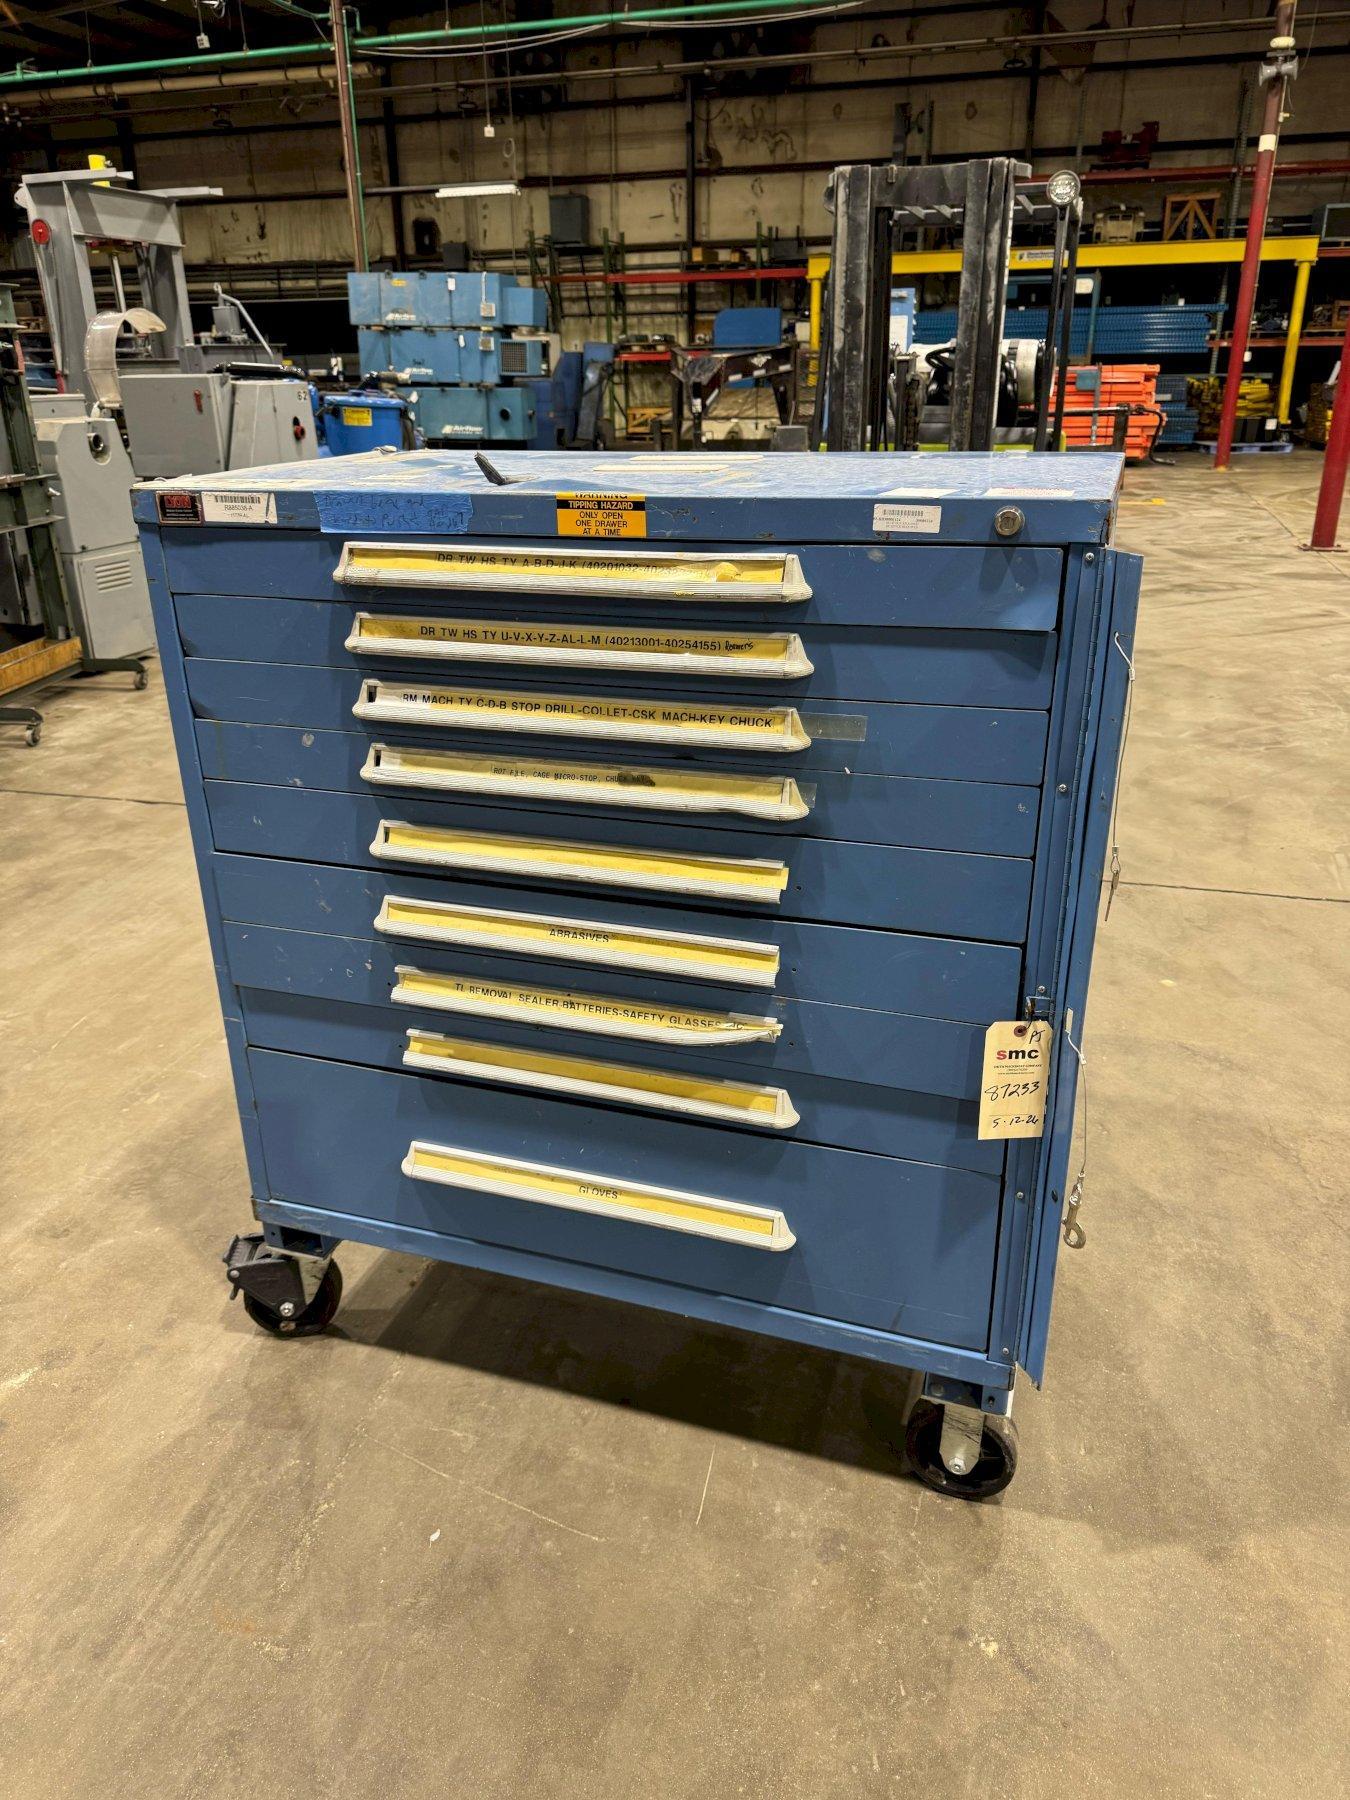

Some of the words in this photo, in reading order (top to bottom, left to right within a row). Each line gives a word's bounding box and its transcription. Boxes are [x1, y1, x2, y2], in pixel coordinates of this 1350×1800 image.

[568, 500, 599, 509] TIPPING
[601, 501, 634, 510] HAZARD
[579, 511, 599, 519] ONLY
[602, 511, 624, 519] OPEN
[575, 519, 592, 527] ONE
[595, 520, 628, 528] DRAWER
[594, 528, 600, 536] A
[603, 528, 621, 536] TIME
[458, 554, 476, 564] TW
[481, 555, 496, 566] HS
[502, 557, 517, 567] TY
[420, 625, 436, 636] DR
[441, 627, 458, 637] TW
[463, 629, 478, 639] HS
[482, 630, 497, 641] TY
[501, 631, 601, 645] U-V-X-Y-Z-AL-L-M
[605, 636, 721, 651] (40213001-40254155)
[402, 693, 418, 702] RM
[422, 694, 454, 705] MACH
[458, 697, 473, 707] TY
[476, 698, 507, 710] C-D-B
[511, 701, 541, 712] STOP
[545, 703, 657, 720] DRILL-COLLET-CSK
[662, 711, 726, 724] MACH-KEY
[729, 716, 773, 728] CHUCK
[533, 771, 550, 779] CAGE
[549, 928, 610, 943] ABRASIVES
[996, 1049, 1040, 1061] smc
[984, 1081, 1040, 1101] 87233
[579, 1185, 619, 1199] GLOVES
